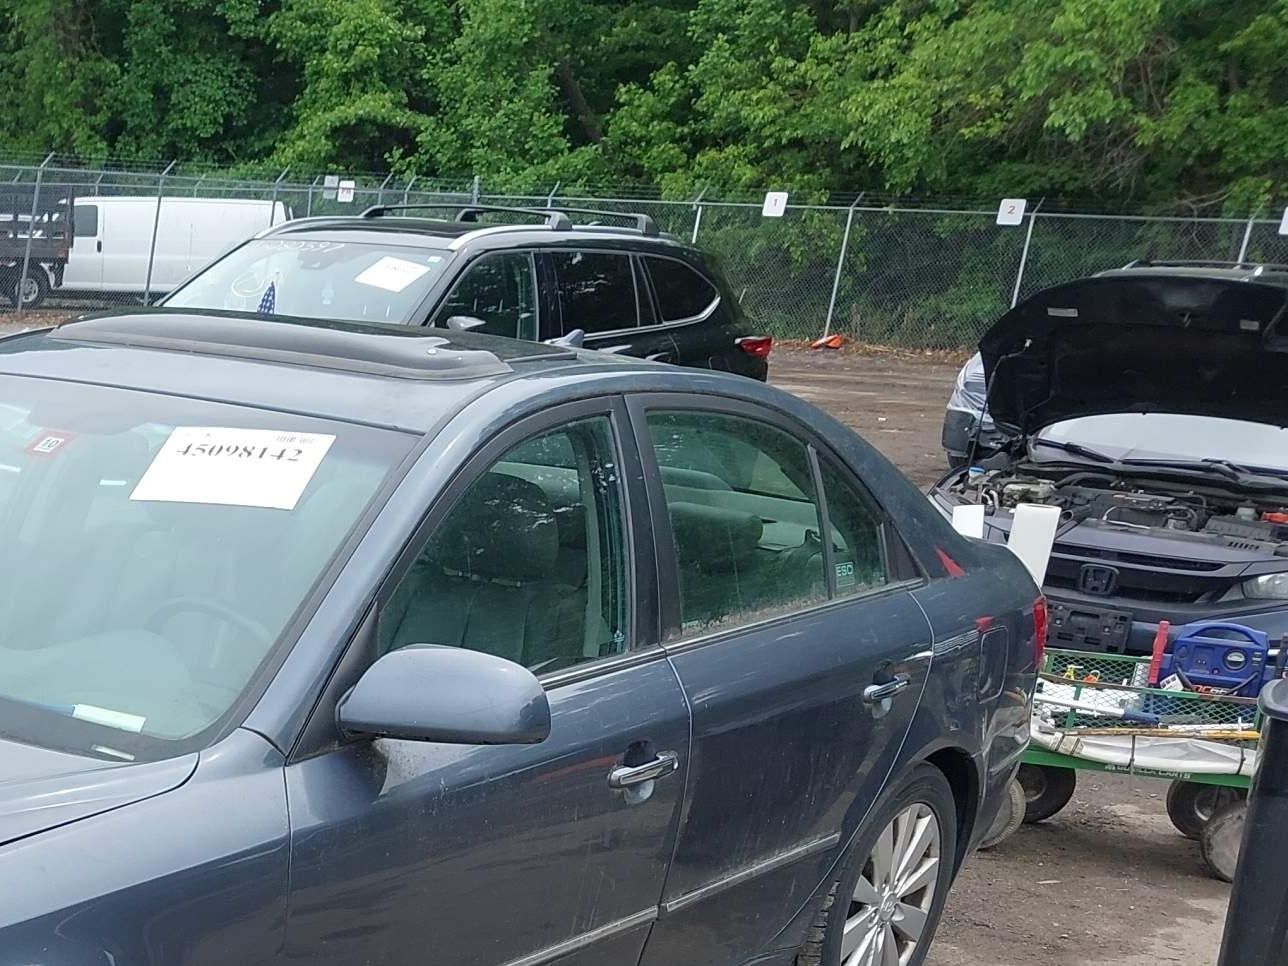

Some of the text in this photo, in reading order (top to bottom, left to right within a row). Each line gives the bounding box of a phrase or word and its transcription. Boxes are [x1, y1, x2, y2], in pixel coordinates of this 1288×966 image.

[1007, 205, 1017, 215] 2
[41, 438, 60, 449] 10
[176, 442, 304, 463] 45098142
